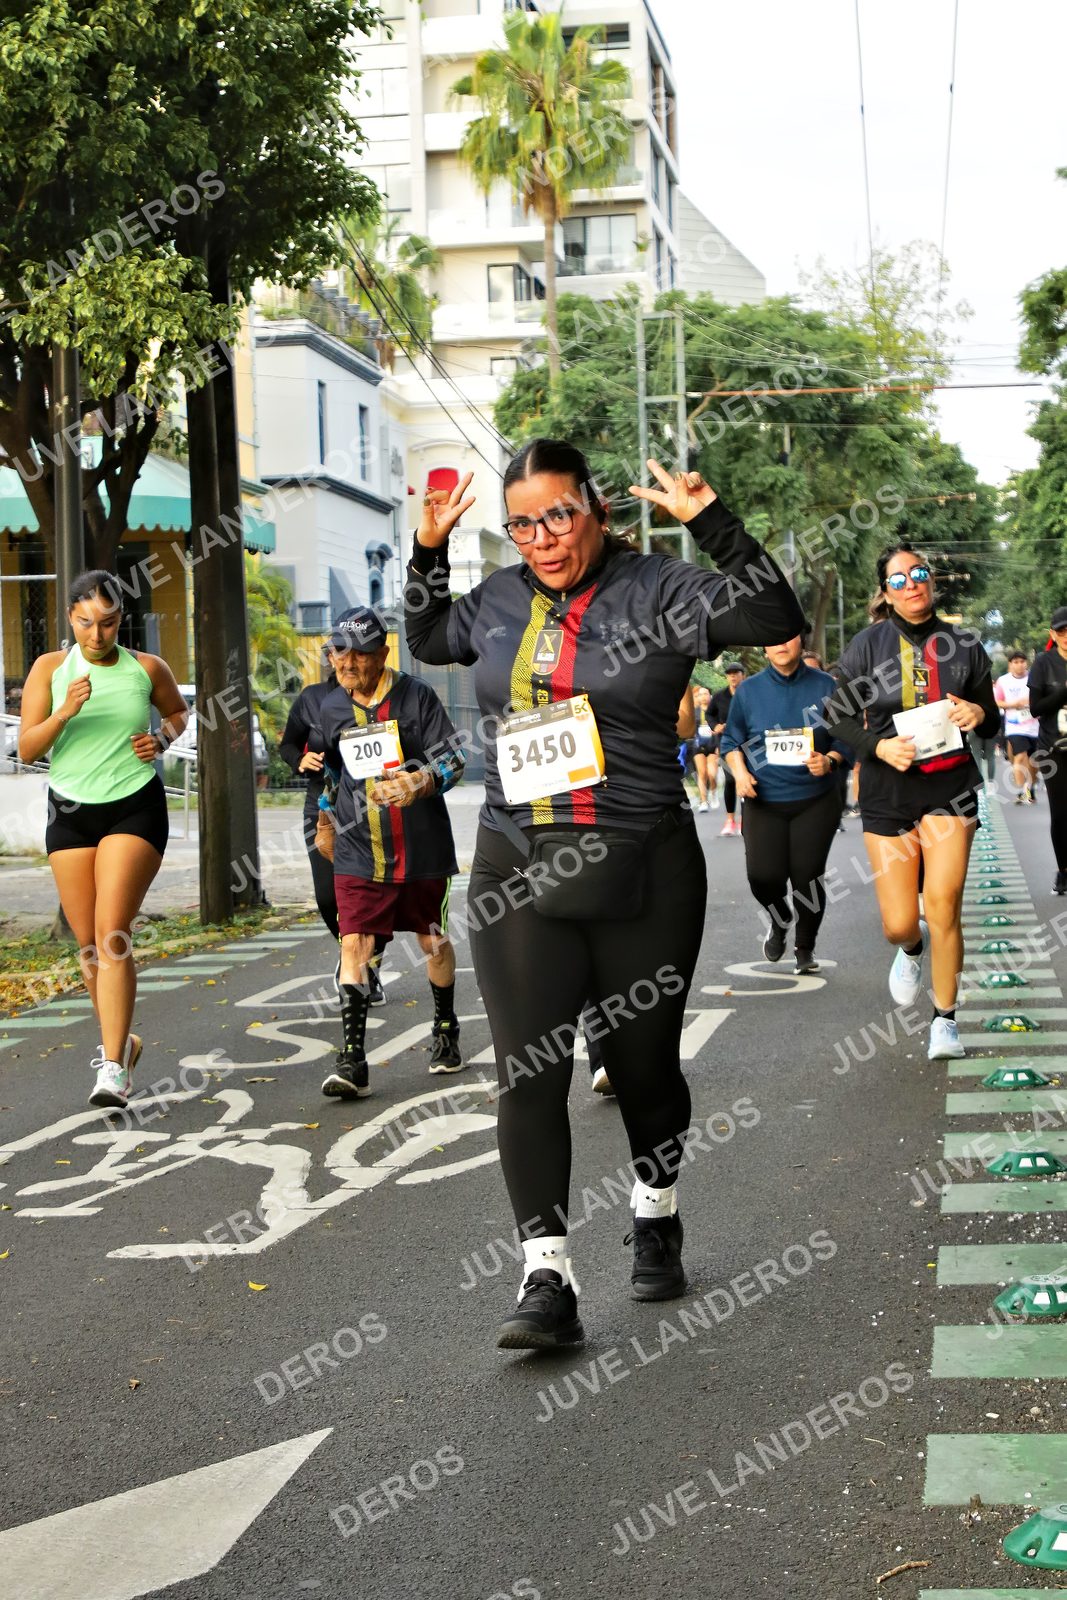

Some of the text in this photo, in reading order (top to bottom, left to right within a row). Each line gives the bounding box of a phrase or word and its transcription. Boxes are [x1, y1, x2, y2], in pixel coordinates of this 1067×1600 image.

[353, 741, 382, 760] 200
[509, 730, 577, 773] 3450
[772, 741, 803, 752] 7079
